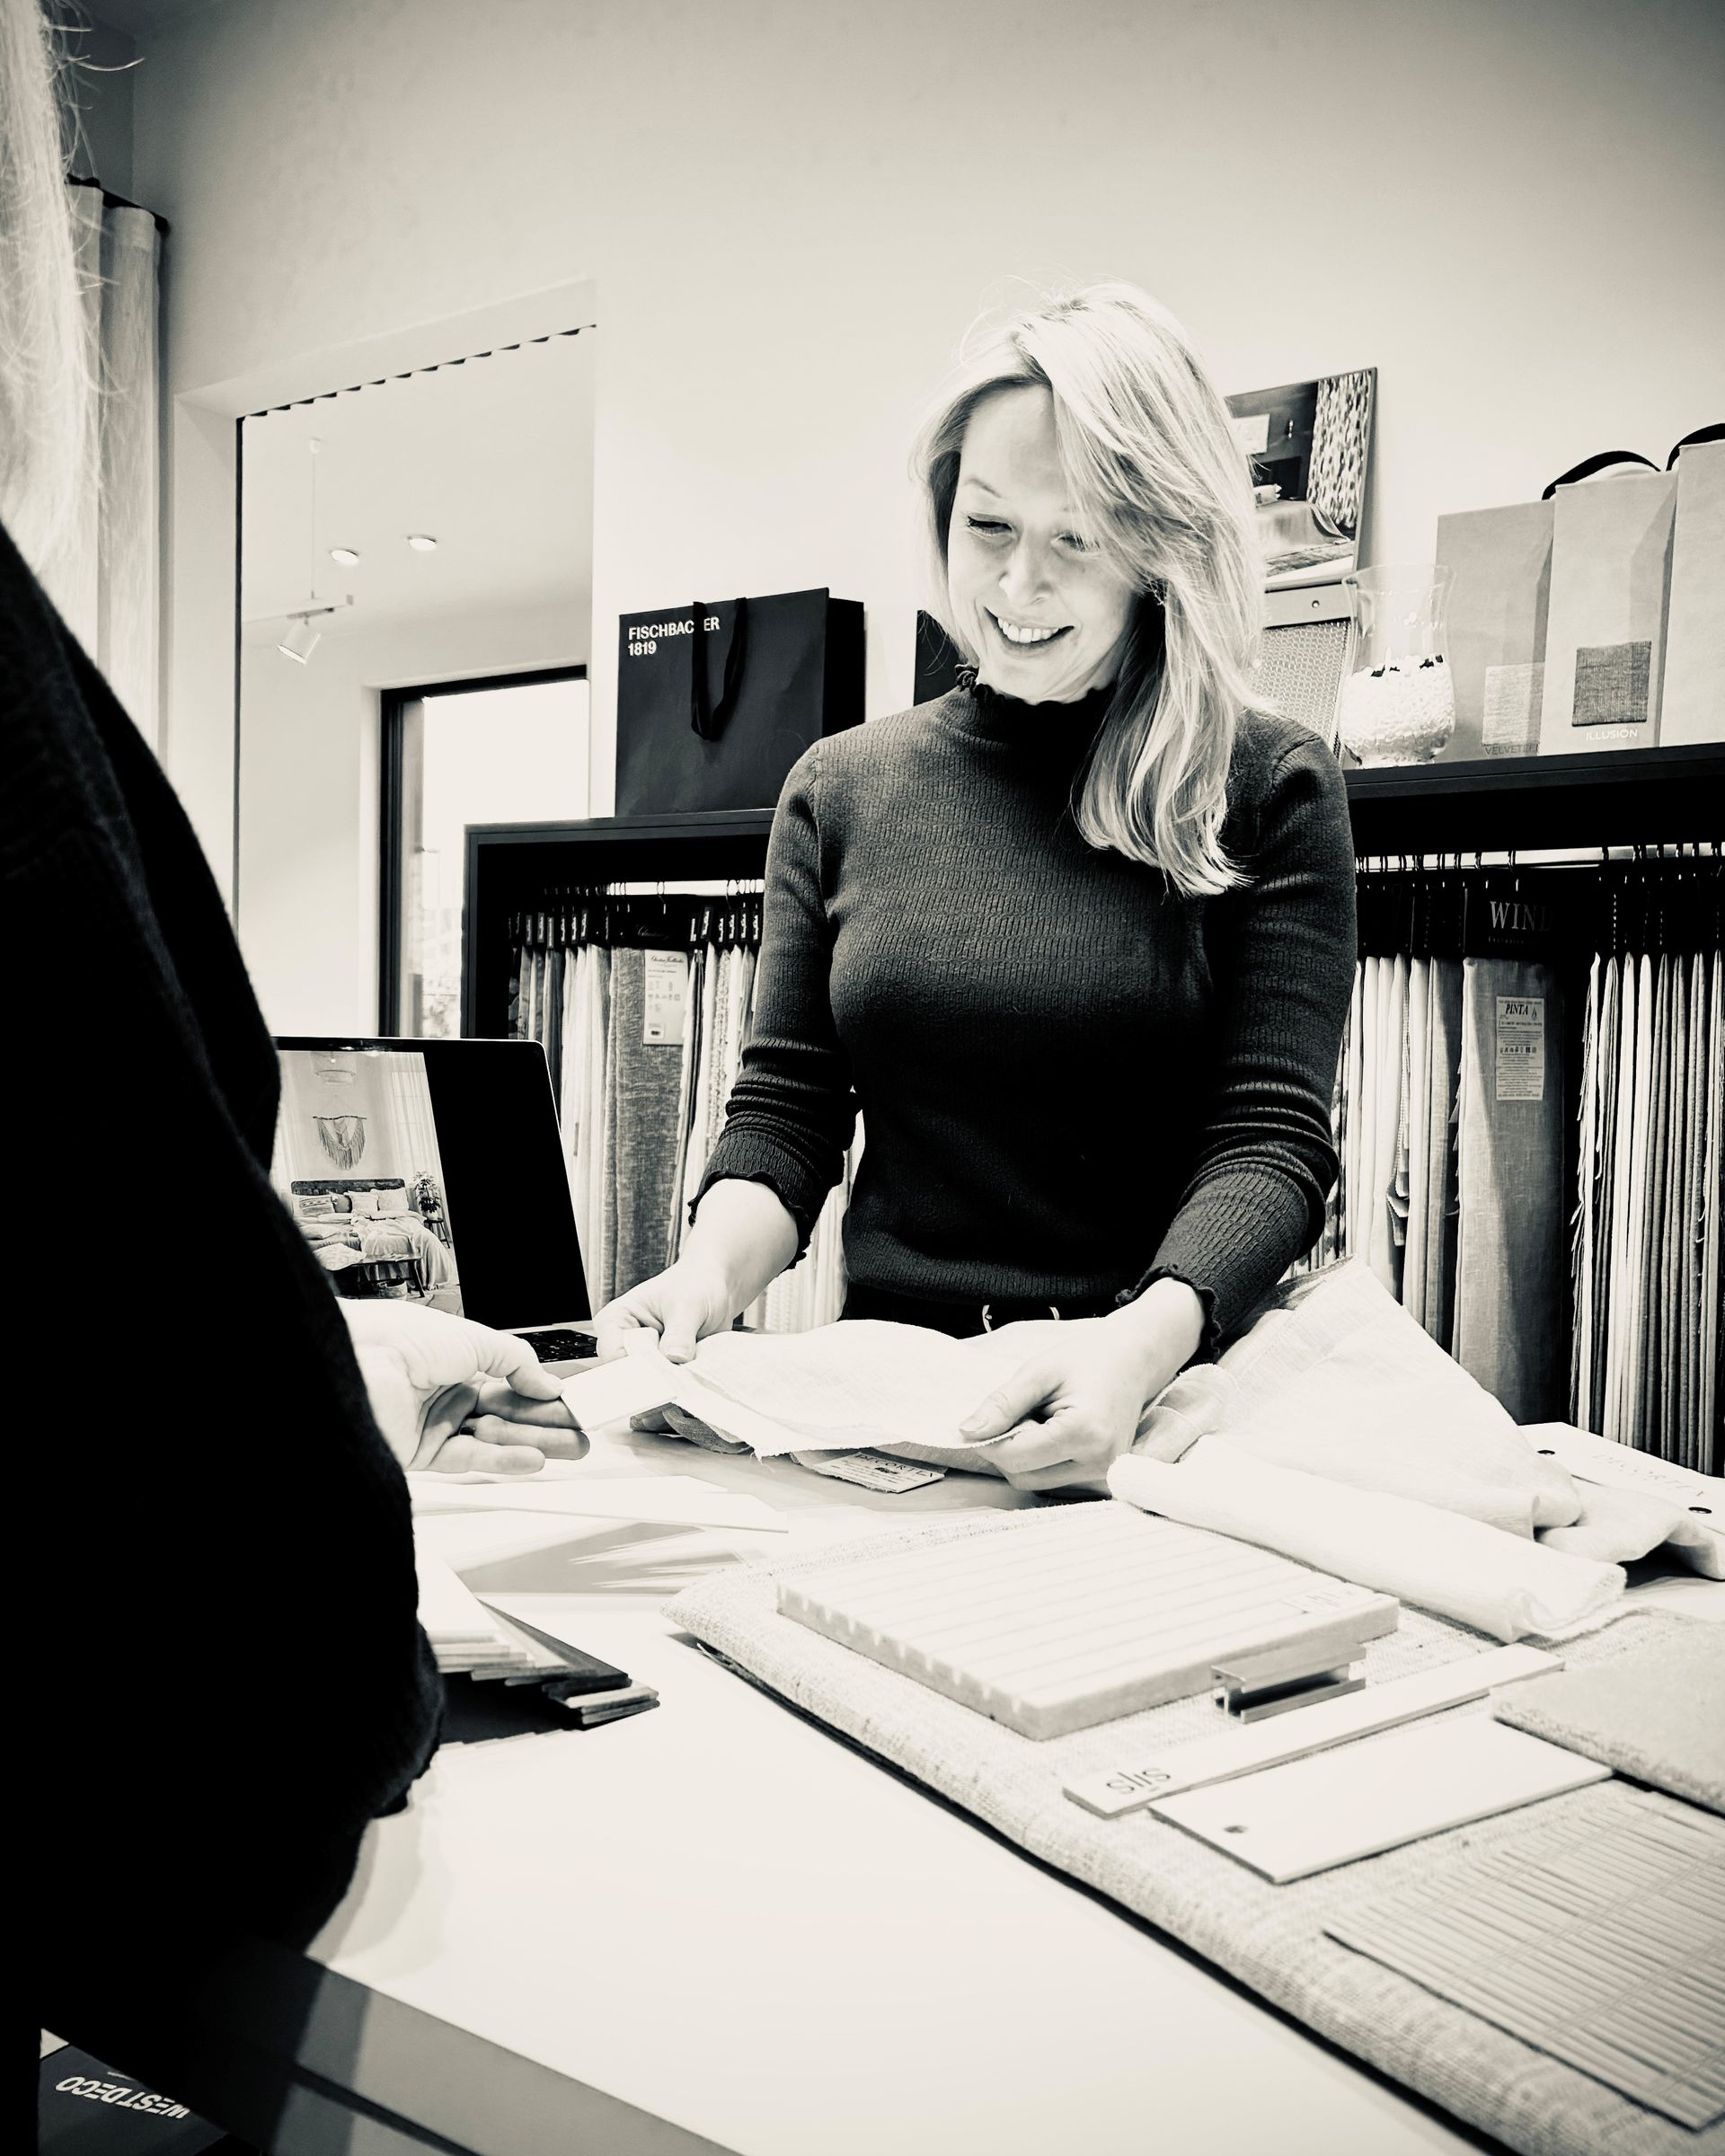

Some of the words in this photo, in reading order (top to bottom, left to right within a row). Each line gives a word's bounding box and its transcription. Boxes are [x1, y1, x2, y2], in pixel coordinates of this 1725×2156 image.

[628, 616, 721, 641] FISCHBACER
[627, 641, 658, 656] 1819
[1586, 729, 1638, 740] ILLUSION
[1506, 1003, 1529, 1015] PINTA
[55, 2076, 190, 2119] WESTDECO
